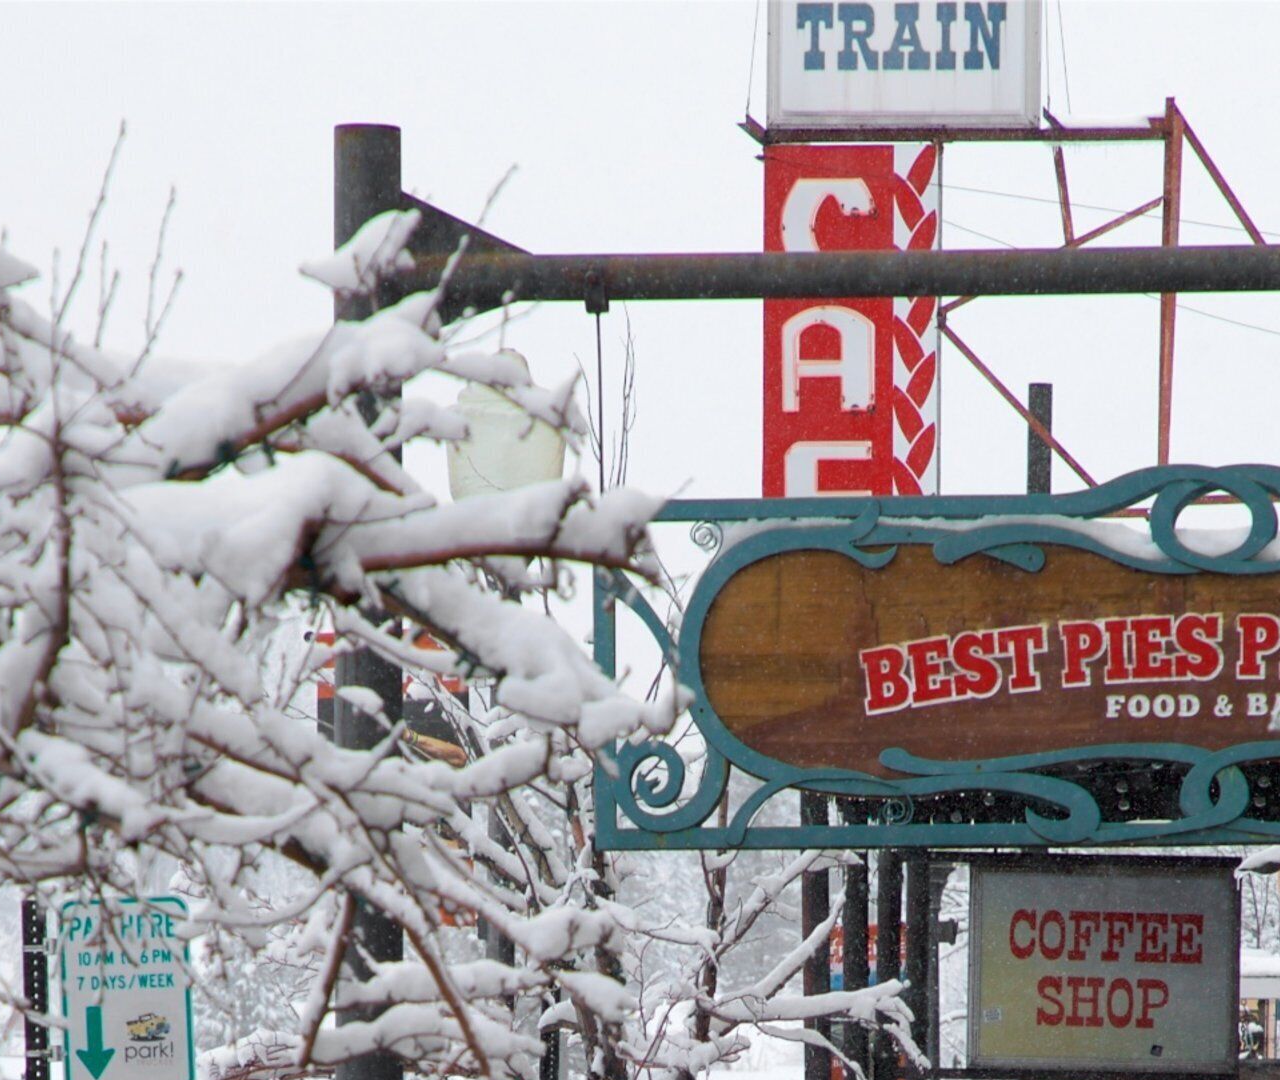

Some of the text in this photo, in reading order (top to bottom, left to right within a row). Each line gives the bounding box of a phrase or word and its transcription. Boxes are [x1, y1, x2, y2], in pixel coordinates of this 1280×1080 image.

[796, 1, 1007, 71] TRAIN
[859, 624, 1048, 715] BEST
[1059, 613, 1223, 689] PIES
[1106, 694, 1200, 718] FOOD
[1213, 694, 1233, 717] &
[1009, 908, 1205, 965] COFFEE
[78, 951, 91, 966] 10
[152, 949, 172, 963] PM
[77, 976, 85, 991] 7
[1036, 976, 1170, 1029] SHOP
[124, 1041, 174, 1063] park!
